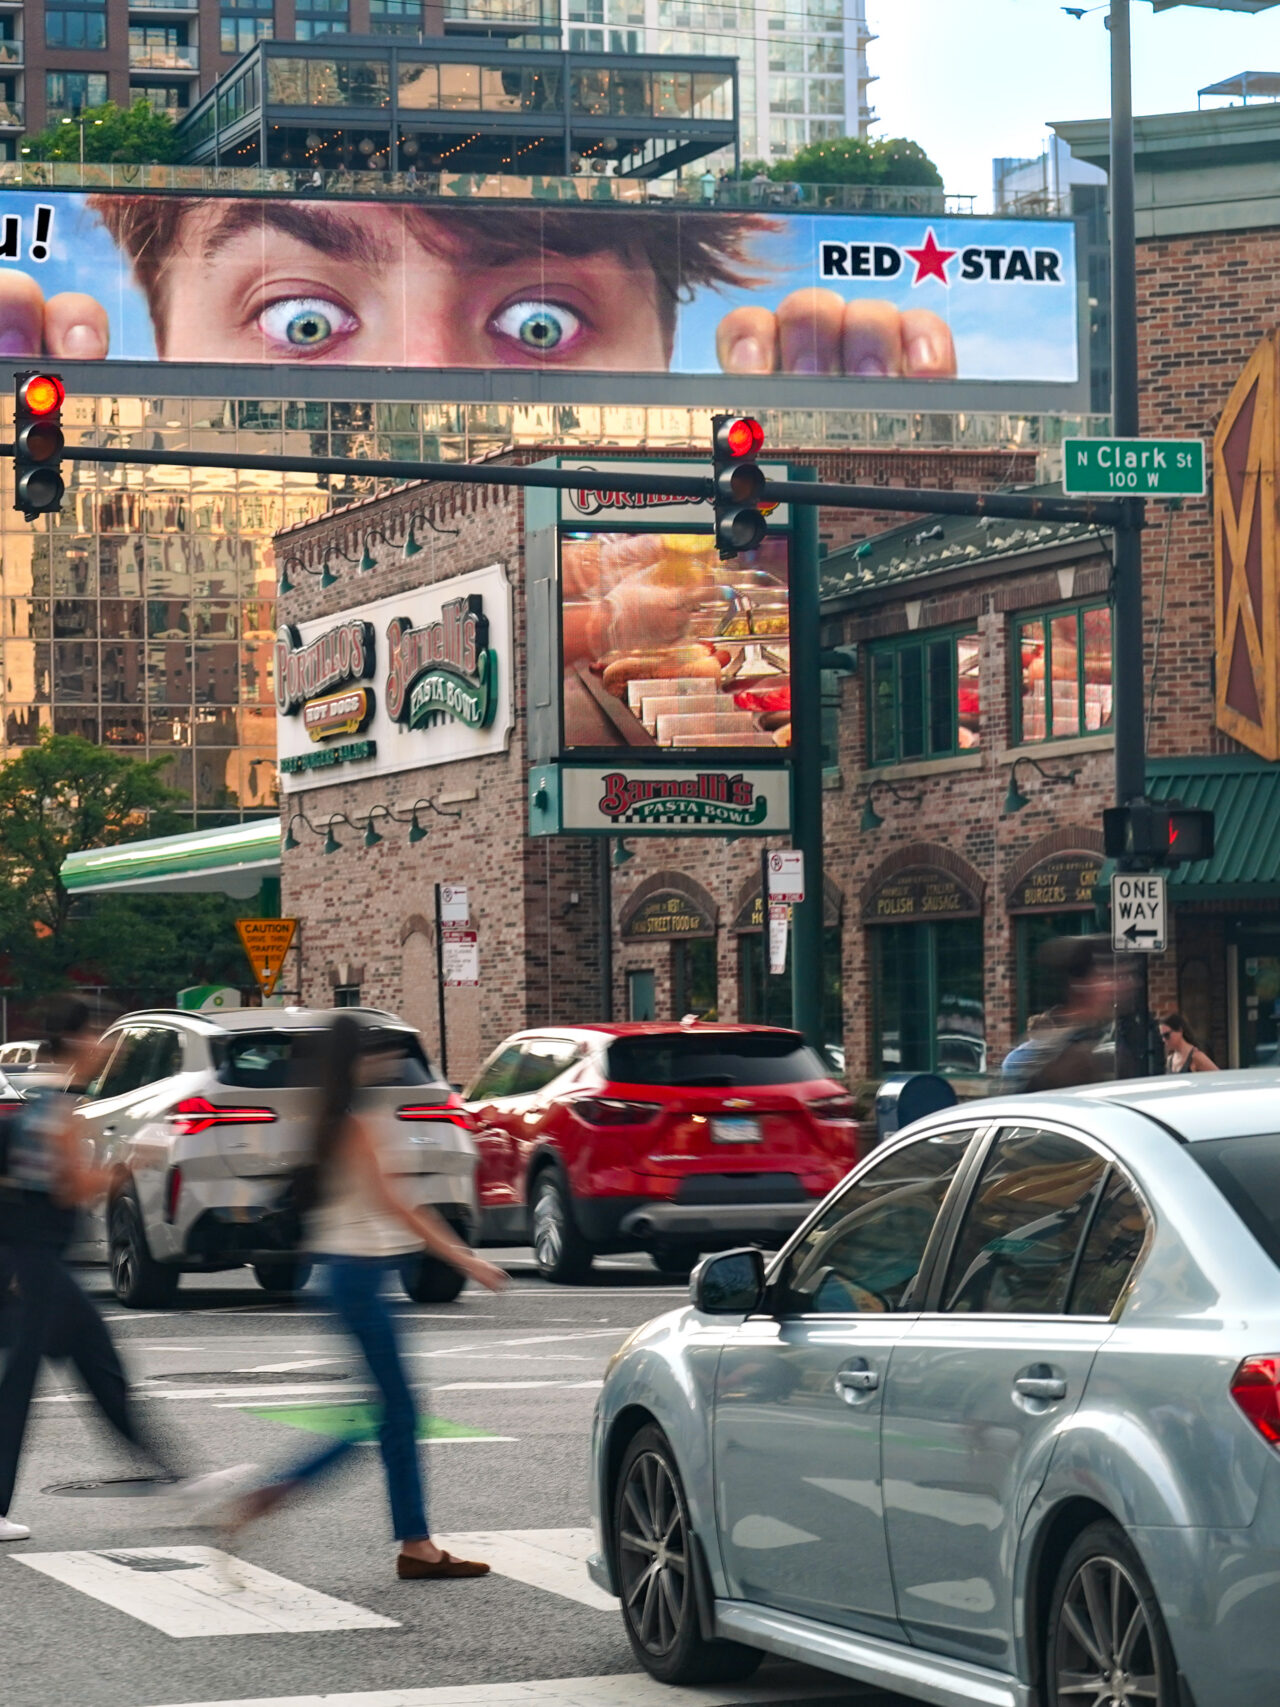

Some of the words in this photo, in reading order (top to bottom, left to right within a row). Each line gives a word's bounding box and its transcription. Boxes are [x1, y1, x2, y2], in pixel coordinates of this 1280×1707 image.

[822, 244, 902, 277] RED
[960, 248, 1062, 282] STAR
[1077, 450, 1089, 467] N
[1097, 445, 1167, 469] Clark
[1175, 451, 1193, 469] St
[1108, 471, 1138, 488] 100
[1147, 472, 1160, 488] W
[410, 676, 445, 716] PASTA
[446, 680, 481, 722] BOWL
[599, 772, 754, 816] Barnelli's
[643, 802, 698, 816] PASTA
[704, 805, 755, 823] BOWL
[1032, 873, 1059, 887] TASTY
[1119, 880, 1158, 899] ONE
[877, 896, 913, 914] POLISH
[921, 893, 960, 912] SAUSAGE
[1024, 886, 1067, 905] BURGERS
[1118, 902, 1159, 920] WAY
[244, 923, 290, 934] CAUTION
